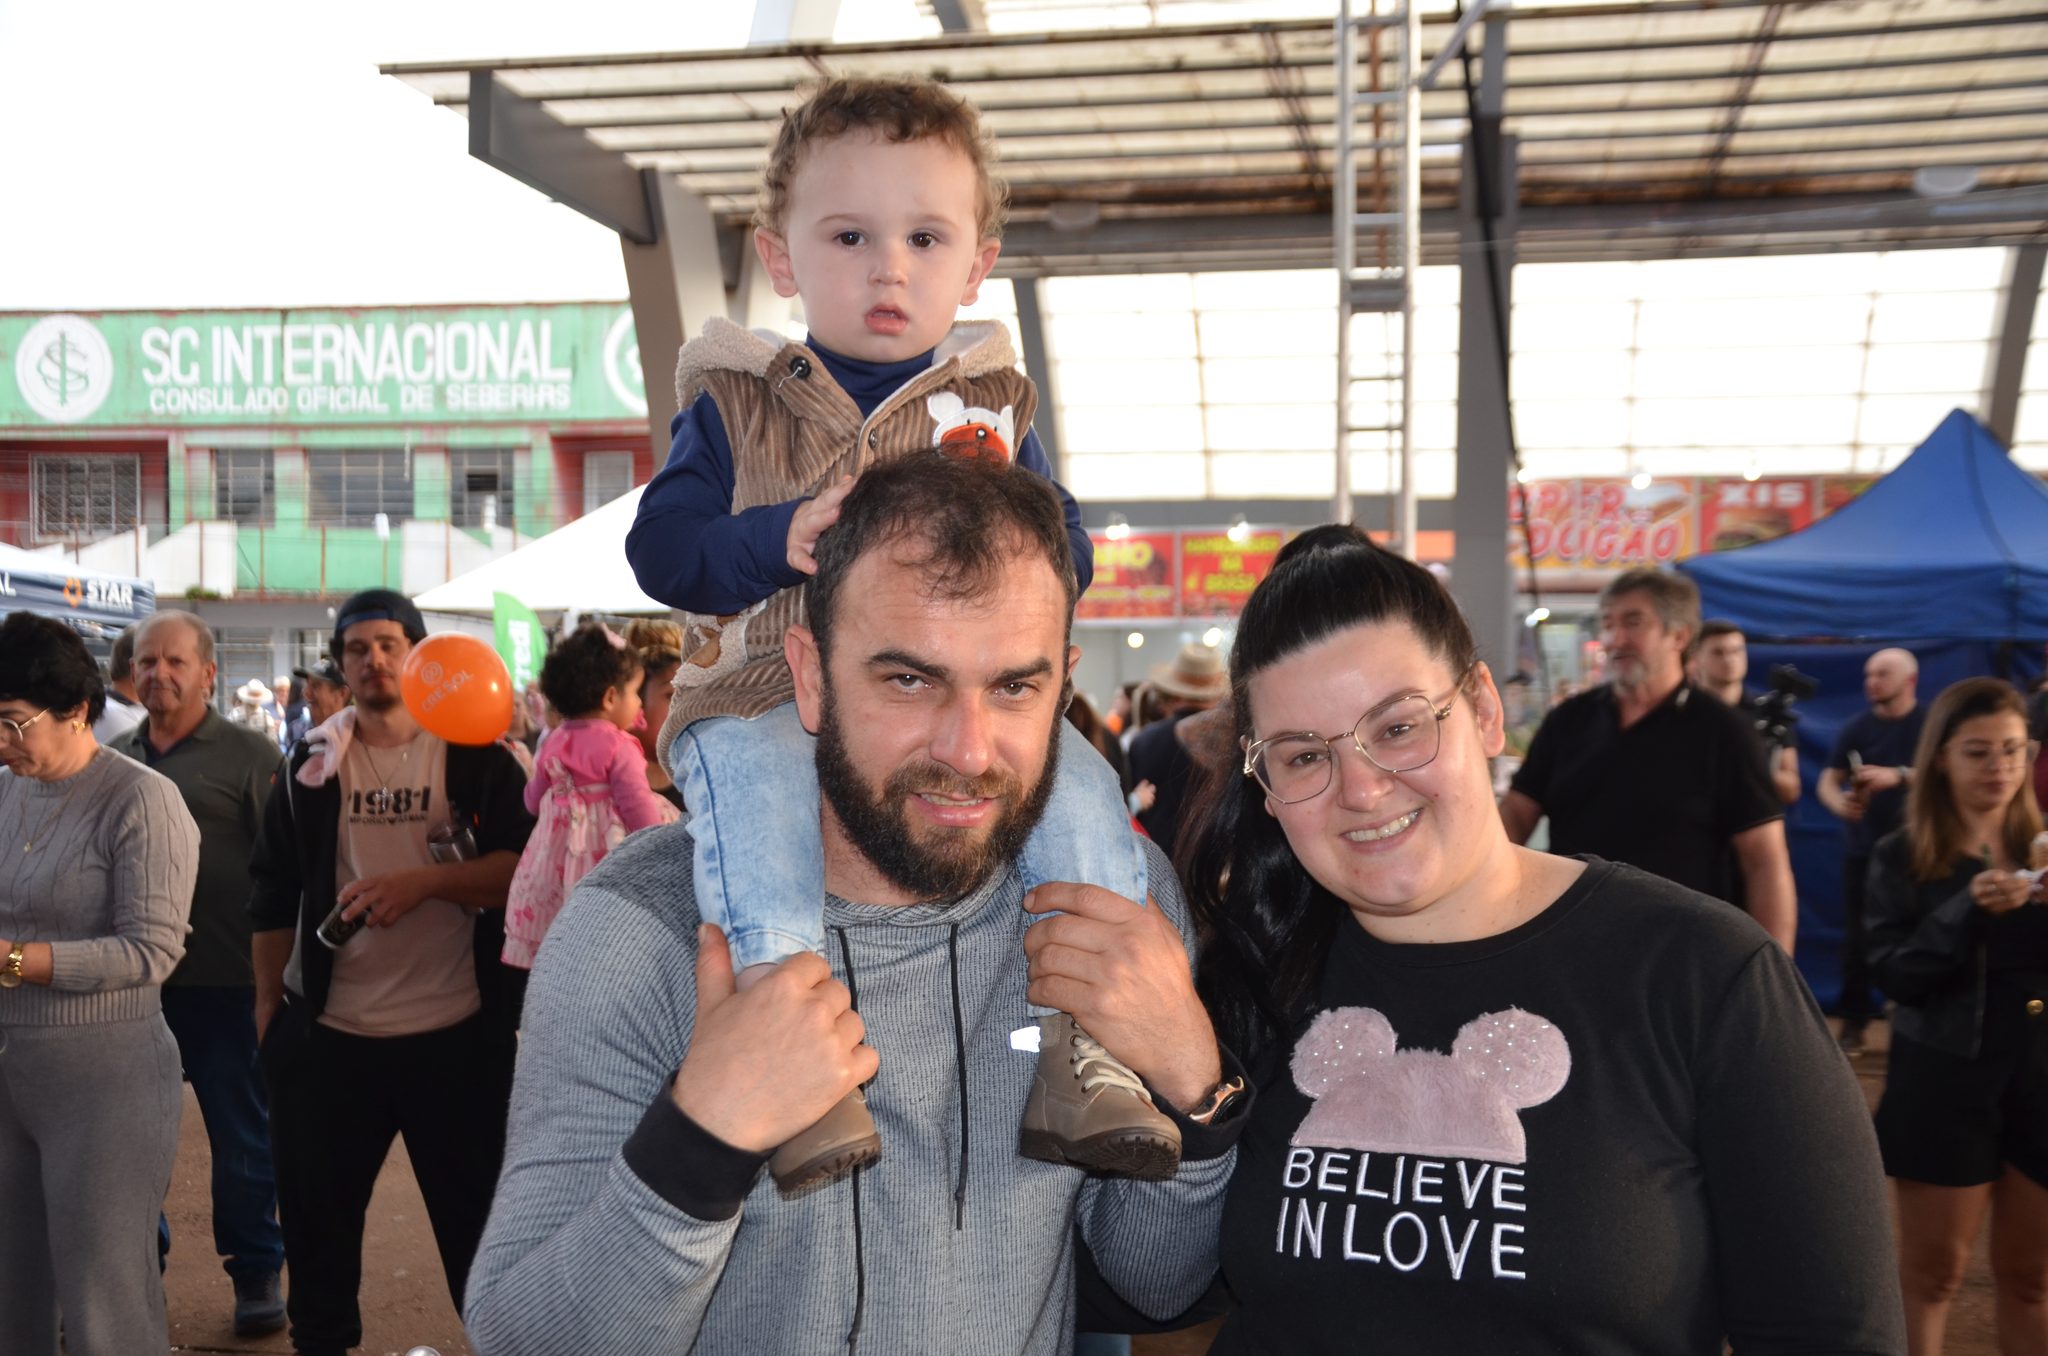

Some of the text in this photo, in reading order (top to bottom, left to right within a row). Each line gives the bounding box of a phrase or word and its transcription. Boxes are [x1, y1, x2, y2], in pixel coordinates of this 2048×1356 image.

[141, 319, 572, 387] SC INTERNACIONAL
[150, 386, 289, 415] CONSULADO
[297, 384, 390, 415] OFICIAL
[401, 383, 435, 412] DE
[1719, 482, 1806, 509] XIS
[86, 579, 134, 607] STAR
[347, 786, 431, 815] 1981
[1283, 1147, 1527, 1212] BELIEVE
[1276, 1196, 1527, 1281] IN LOVE
